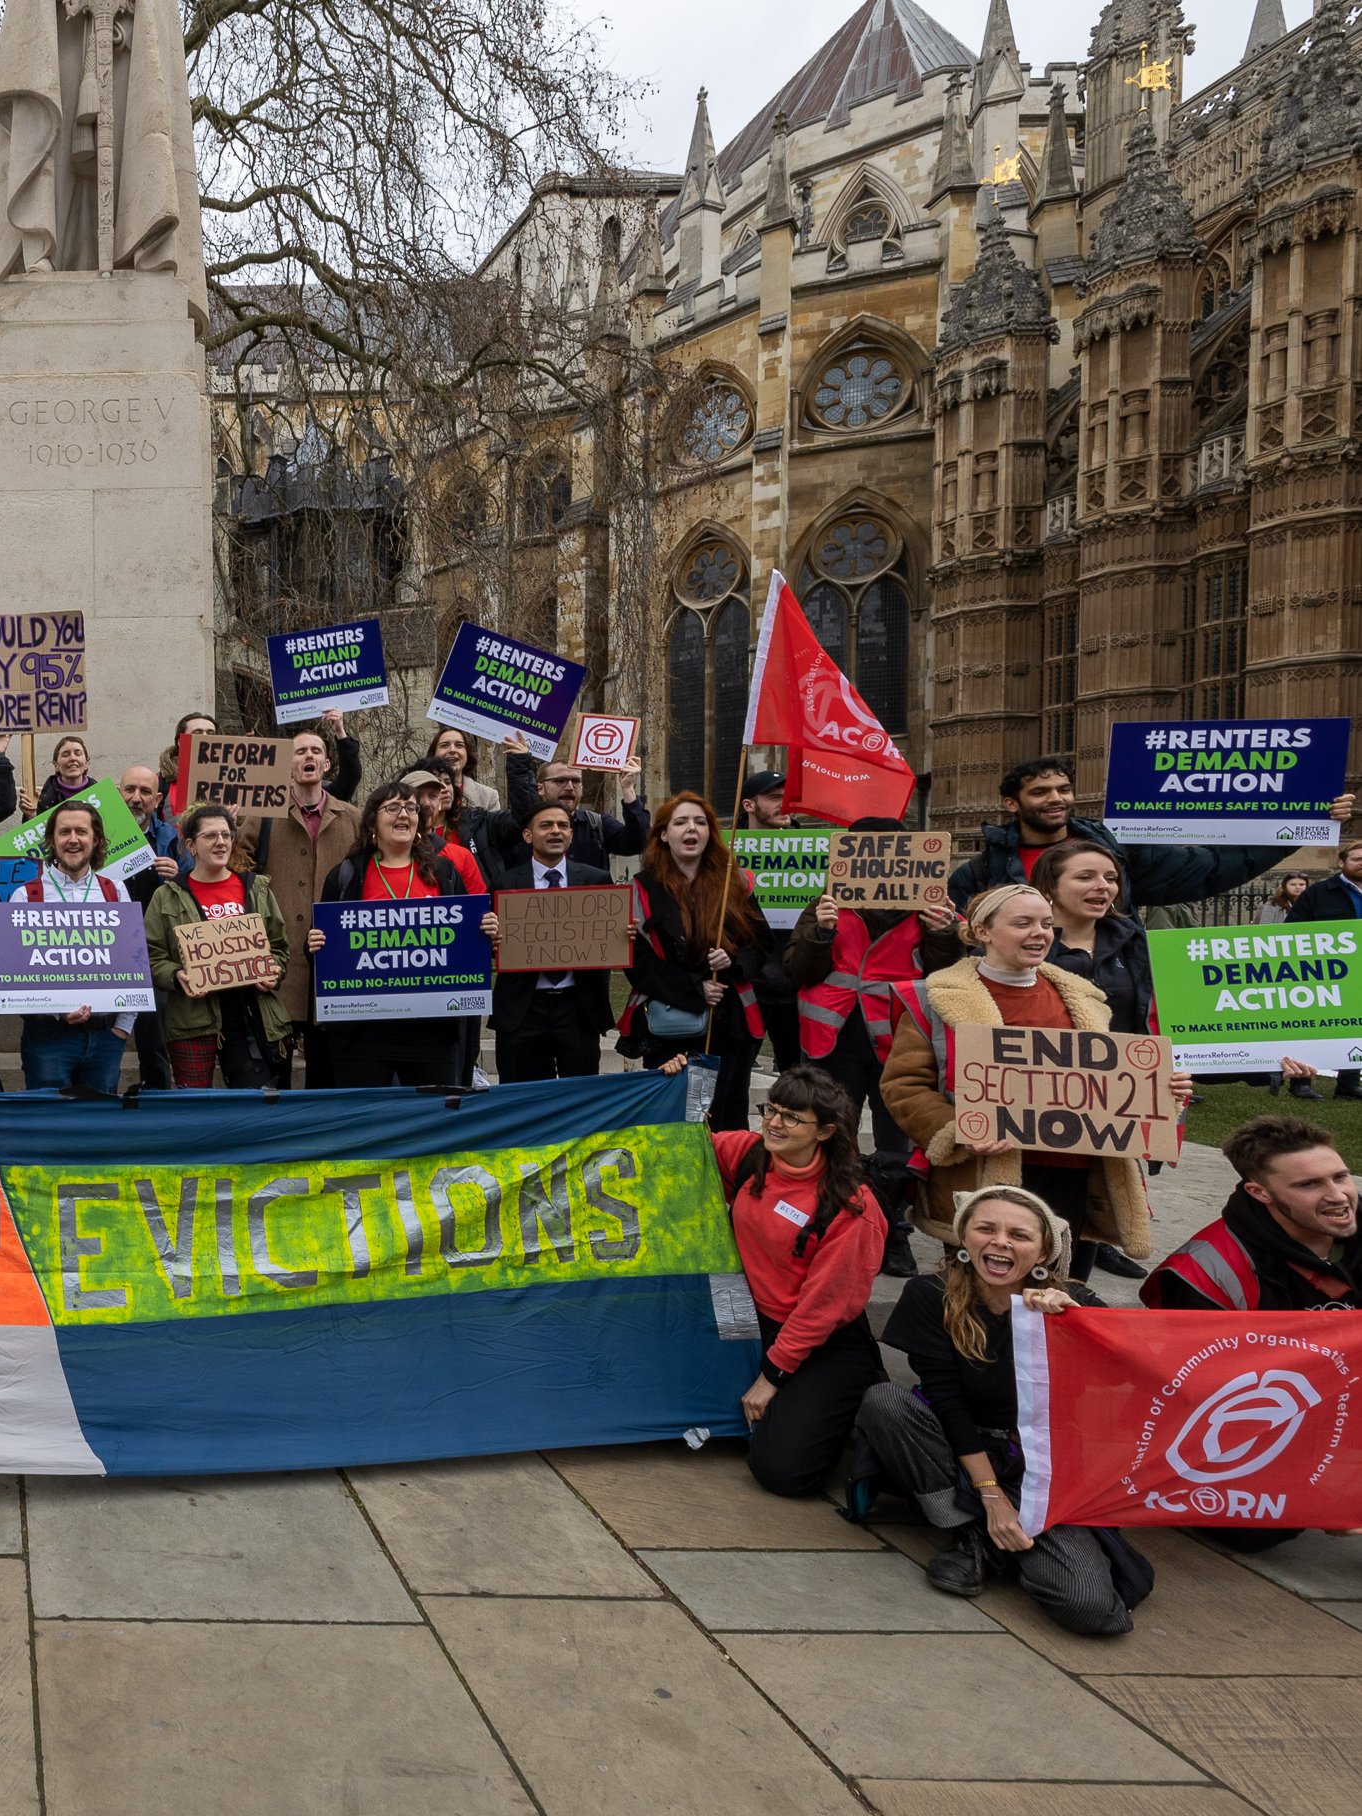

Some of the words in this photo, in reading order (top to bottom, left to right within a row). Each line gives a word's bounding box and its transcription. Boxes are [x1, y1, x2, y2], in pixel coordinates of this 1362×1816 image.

[9, 399, 141, 425] GEORGE
[27, 440, 158, 467] 1910-1936
[285, 628, 364, 654] #RENTERS
[293, 645, 360, 668] DEMAND
[476, 636, 566, 682] #RENTERS
[20, 652, 83, 689] 95%
[299, 660, 357, 683] ACTION
[475, 656, 552, 696] DEMAND
[472, 675, 541, 712] ACTION
[35, 689, 87, 727] RENT?
[1145, 728, 1311, 749] #RENTERS
[198, 742, 276, 766] REFORM
[1155, 751, 1298, 771] DEMAND
[219, 766, 246, 782] FOR
[1159, 773, 1284, 793] ACTION
[196, 781, 287, 807] RENTERS
[1115, 802, 1131, 810] TO
[1134, 802, 1171, 810] MAKE
[1176, 802, 1222, 810] HOMES
[1226, 802, 1258, 810] SAFE
[1262, 802, 1278, 810] TO
[1282, 802, 1310, 810] LIVE
[1315, 803, 1331, 811] IN
[729, 837, 829, 852] #RENTER
[837, 835, 912, 857] SAFE
[755, 872, 824, 887] CTION
[850, 859, 945, 879] HOUSING
[11, 910, 120, 927] #RENTERS
[340, 905, 463, 928] #RENTERS
[505, 894, 623, 920] LANDLORD
[21, 929, 115, 946] DEMAND
[180, 926, 204, 940] WE
[212, 917, 258, 935] WANT
[350, 927, 455, 949] DEMAND
[506, 920, 617, 944] REGISTER
[29, 949, 111, 966] ACTION
[187, 932, 267, 961] HOUSING
[1187, 932, 1357, 962] #RENTERS
[356, 948, 447, 970] ACTION
[191, 955, 274, 988] JUSTICE
[322, 981, 336, 989] TO
[340, 980, 362, 988] END
[366, 977, 421, 987] NO-FAULT
[424, 974, 484, 985] EVICTIONS
[1202, 959, 1348, 986] DEMAND
[1215, 985, 1342, 1012] ACTION
[1171, 1025, 1185, 1033] TO
[1189, 1023, 1223, 1032] MAKE
[1227, 1021, 1278, 1031] RENTING
[1282, 1020, 1316, 1028] MORE
[992, 1028, 1118, 1071] END
[963, 1062, 1107, 1111] SECTION
[1114, 1071, 1169, 1121] 21
[57, 1148, 640, 1311] EVICTIONS
[1151, 1397, 1165, 1416] of
[1162, 1336, 1238, 1396] Community
[1330, 1392, 1350, 1447] Reform
[1309, 1454, 1334, 1485] Now
